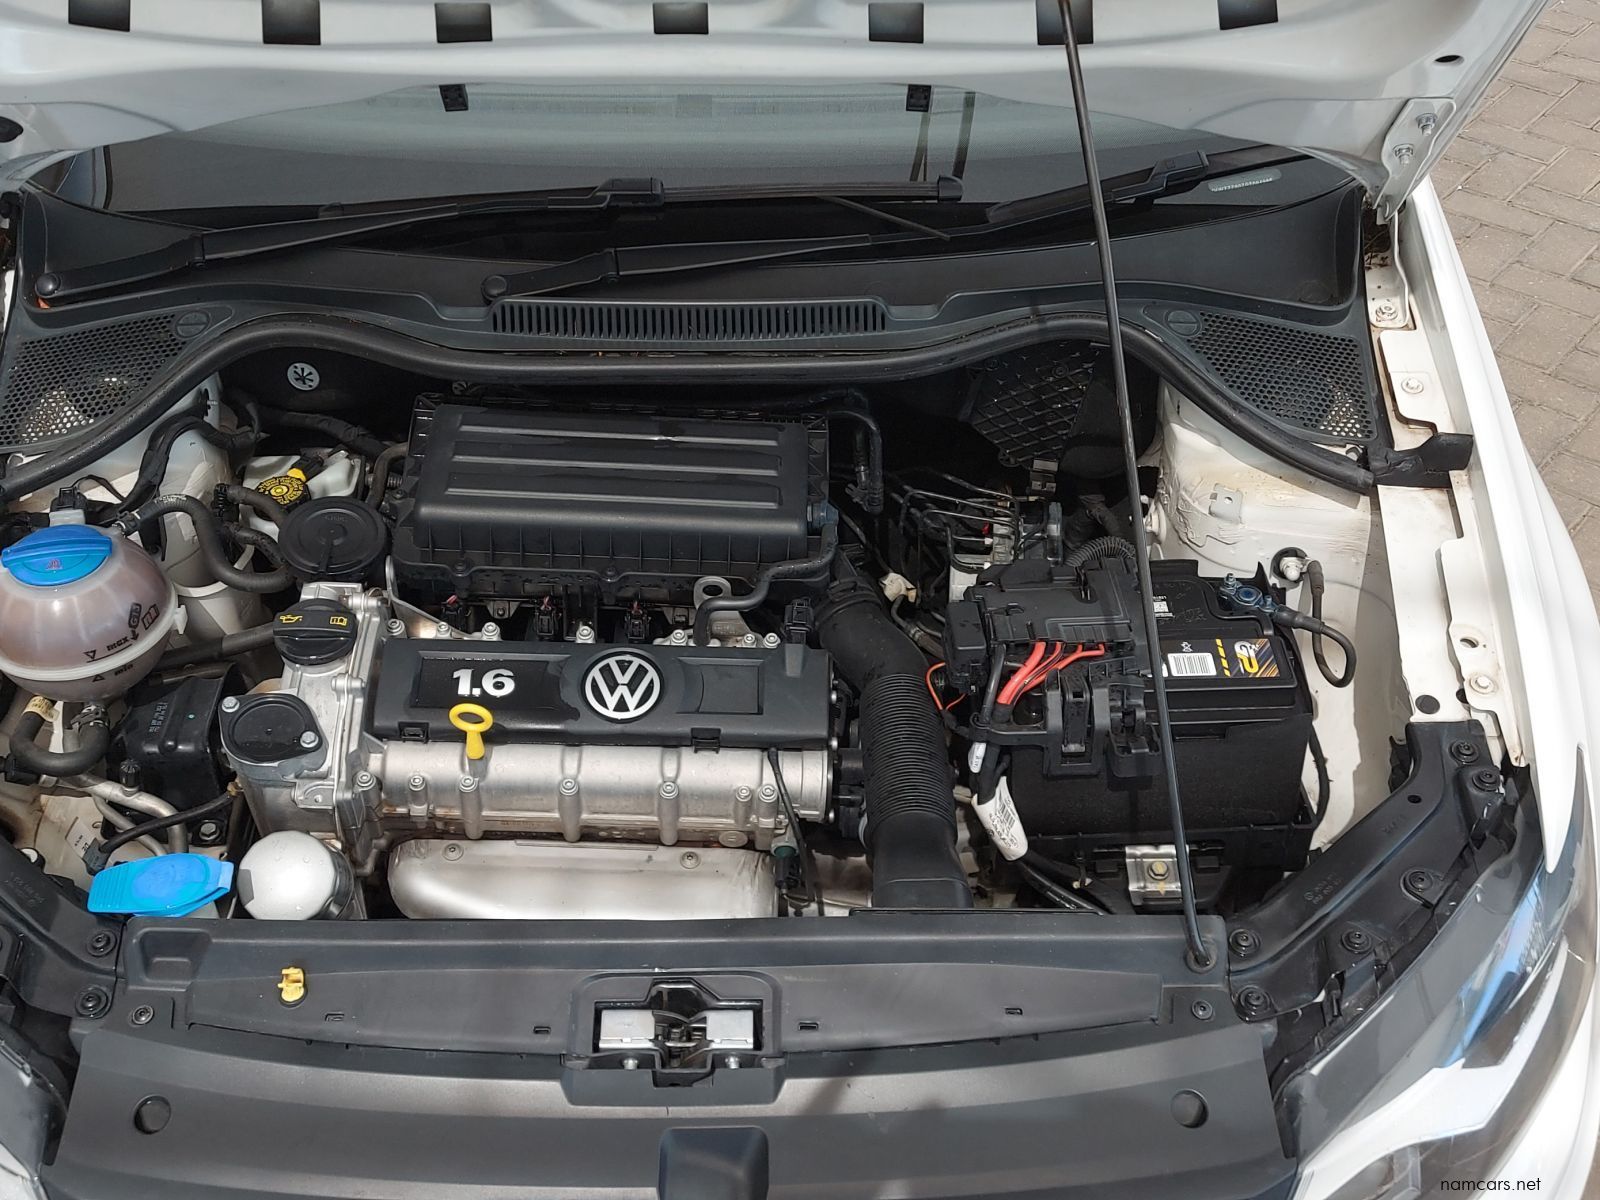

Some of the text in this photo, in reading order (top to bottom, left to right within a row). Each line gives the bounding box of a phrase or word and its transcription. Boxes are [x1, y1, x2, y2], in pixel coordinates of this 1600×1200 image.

[106, 636, 129, 651] max
[452, 668, 515, 697] 1.6
[587, 656, 660, 719] VW
